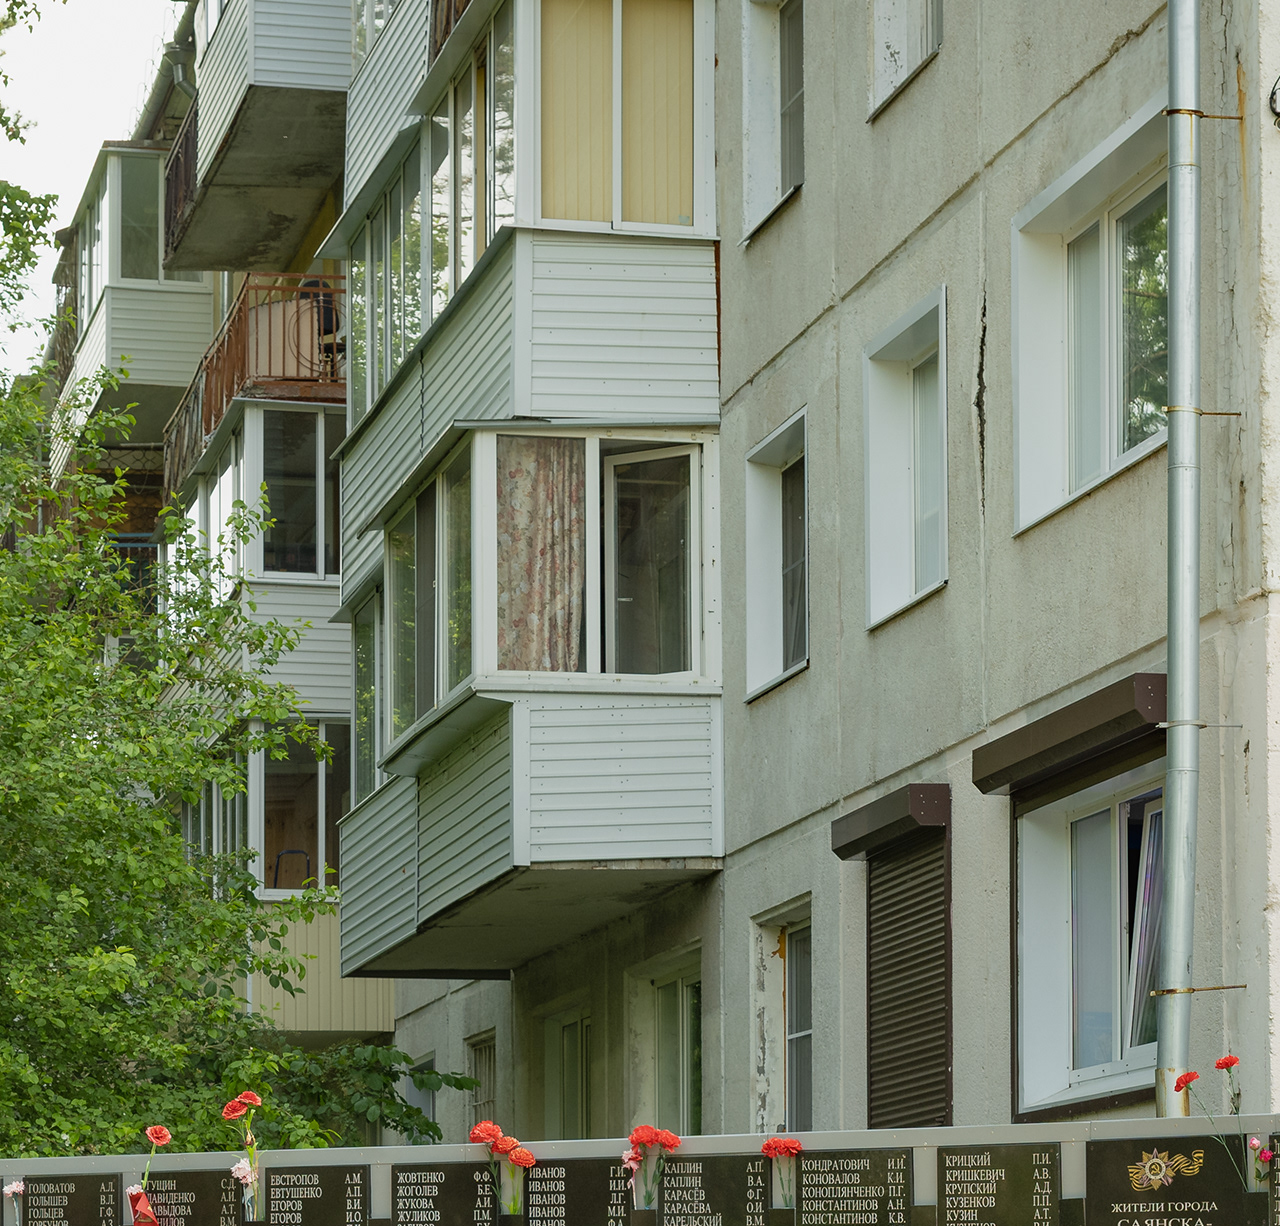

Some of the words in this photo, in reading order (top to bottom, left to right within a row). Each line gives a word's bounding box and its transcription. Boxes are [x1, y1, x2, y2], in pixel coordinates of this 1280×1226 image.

[270, 1174, 320, 1186] ЕВСТРОПОВ
[344, 1173, 363, 1184] А.М.
[270, 1187, 323, 1199] ЕВТУШЕНКО
[345, 1186, 363, 1197] А.П.
[396, 1185, 439, 1197] ЖОГОЛЕВ
[477, 1184, 494, 1195] Б.Е.
[528, 1194, 567, 1205] ИВАНОВ
[609, 1193, 627, 1204] Л.Г.
[1111, 1203, 1164, 1213] ЖИТЕЛИ
[1168, 1201, 1218, 1212] ГОРОДА
[397, 1210, 441, 1222] ЖУЛИКОВ
[473, 1210, 493, 1220] П.М.
